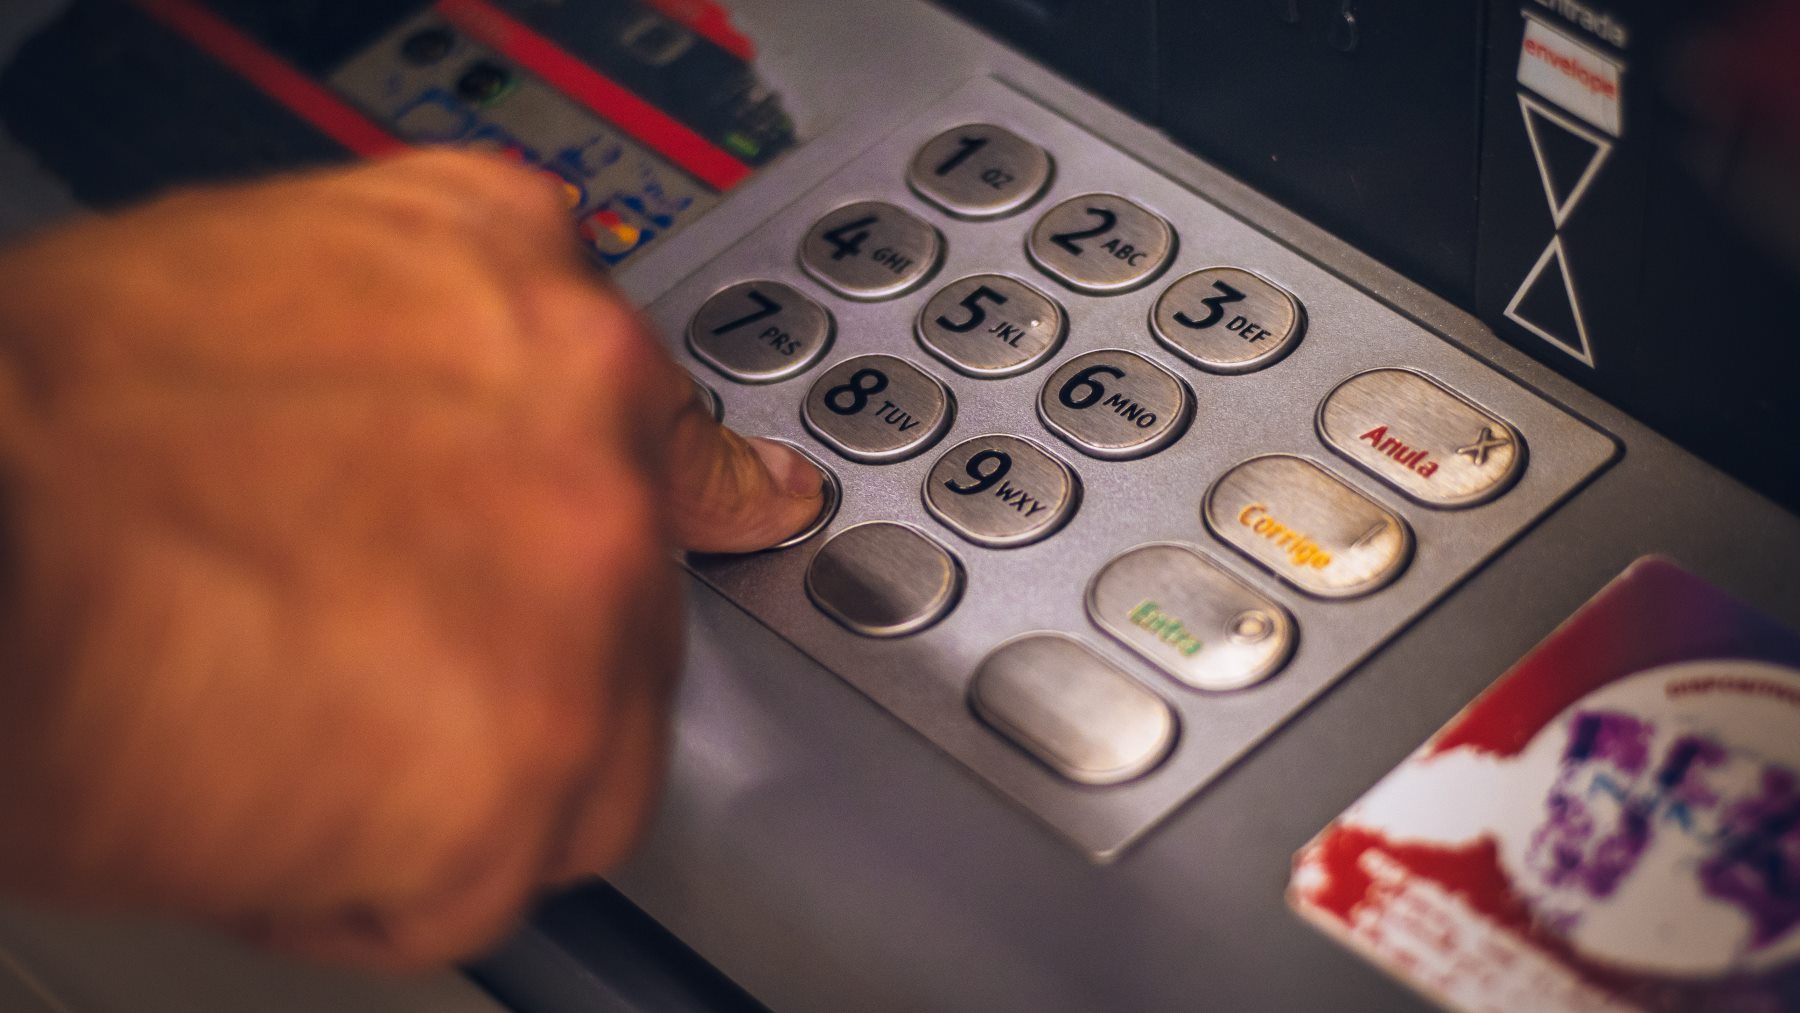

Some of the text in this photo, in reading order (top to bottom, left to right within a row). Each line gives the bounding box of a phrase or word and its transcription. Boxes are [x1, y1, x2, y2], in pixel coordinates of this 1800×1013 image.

[1533, 0, 1626, 48] ntrada
[1524, 39, 1616, 99] envelope
[936, 135, 989, 175] 1
[822, 216, 914, 273] 4 GHI
[1050, 207, 1148, 267] 2 ABC
[713, 290, 801, 356] 7 PRS
[936, 285, 1026, 348] 5 JKL
[1173, 279, 1271, 344] 3 DEF
[824, 368, 920, 432] 8 TUV
[1059, 365, 1157, 429] 6 MNO
[1360, 425, 1440, 478] Anula
[945, 449, 1047, 517] 9 WXY
[1239, 503, 1332, 569] Corrige
[1128, 601, 1202, 657] Entra
